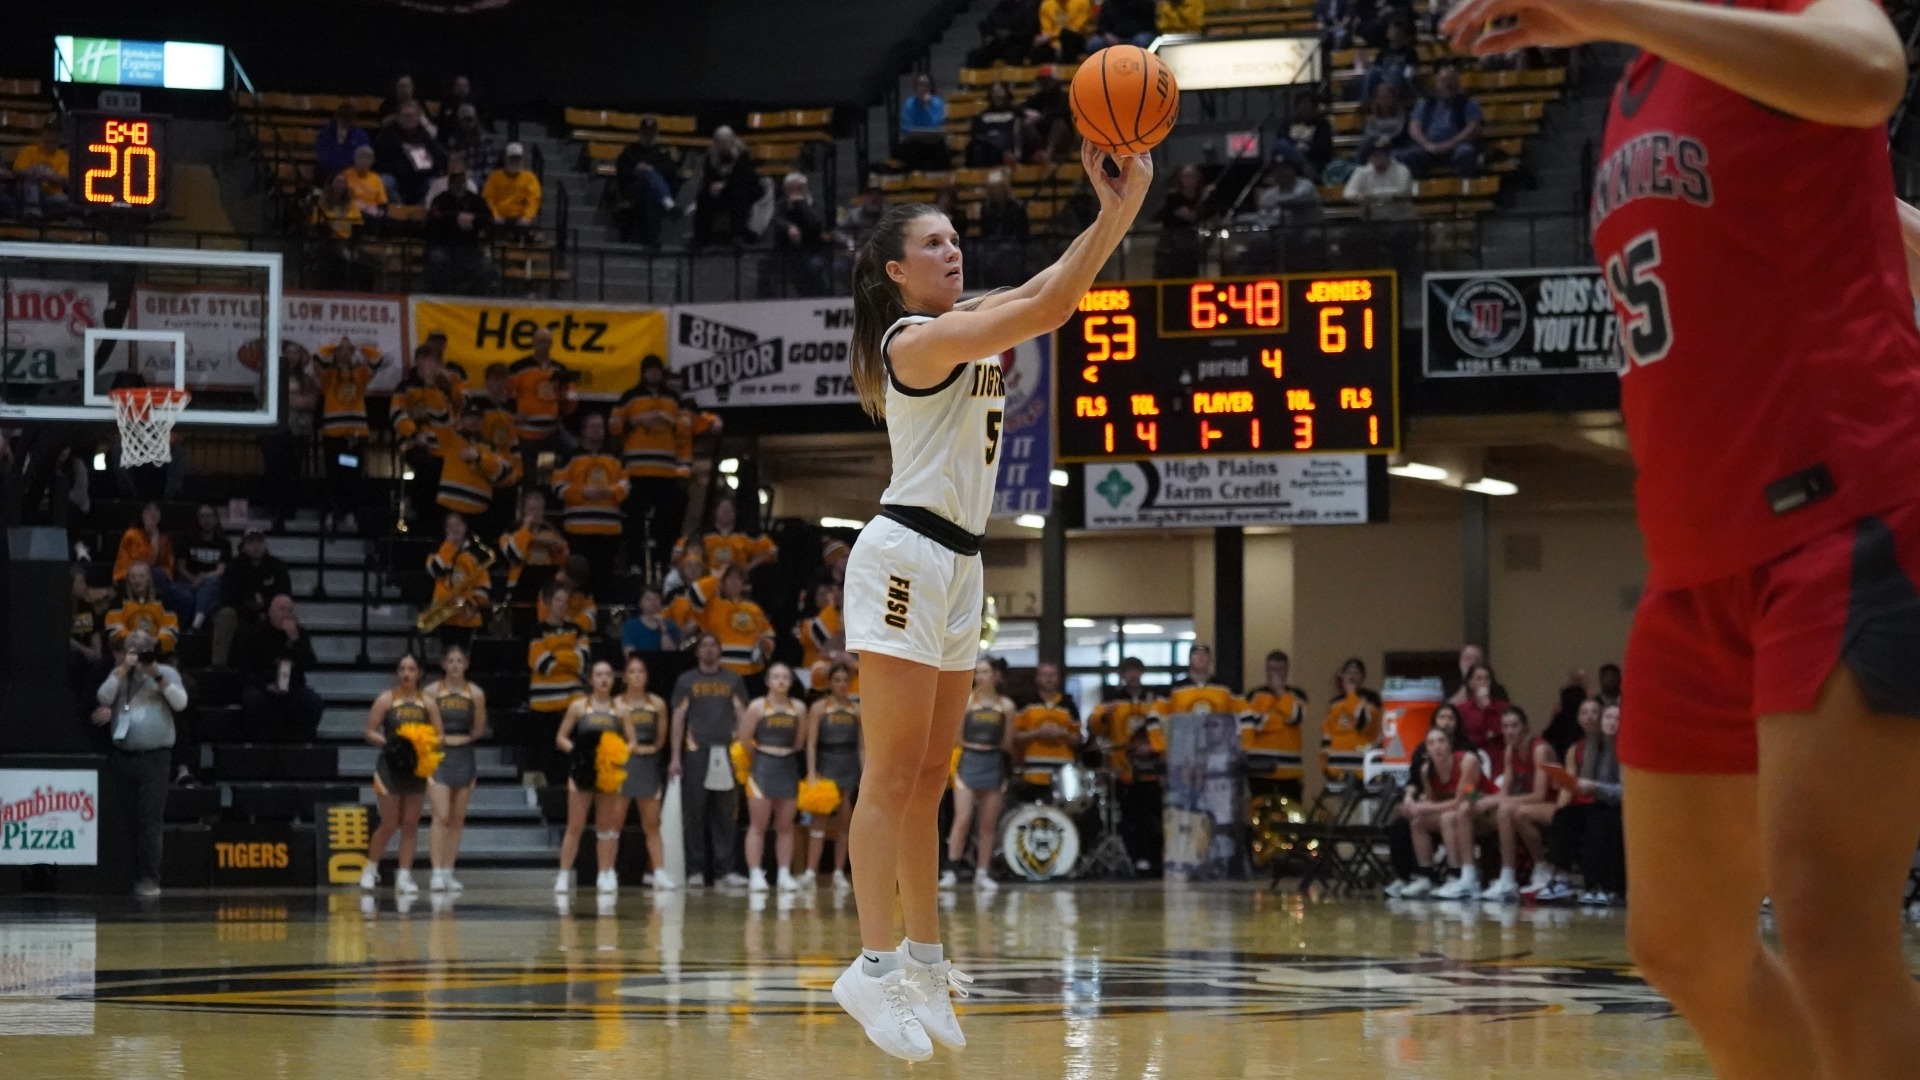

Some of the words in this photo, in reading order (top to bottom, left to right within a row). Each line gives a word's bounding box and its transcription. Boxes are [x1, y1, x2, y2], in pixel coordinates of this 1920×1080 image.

[106, 121, 148, 145] 6:48
[85, 144, 156, 204] 20
[145, 295, 199, 316] GREAT
[288, 301, 323, 321] LOW
[1191, 280, 1280, 329] 6:48
[1537, 277, 1591, 314] SUBS
[689, 319, 732, 352] 8th
[1084, 315, 1137, 361] 53
[1319, 306, 1373, 353] 61
[688, 343, 776, 389] LIQUOR
[788, 341, 848, 365] GOOD
[1198, 357, 1249, 381] period
[1261, 348, 1283, 379] 4
[1076, 395, 1107, 417] FLS
[1131, 394, 1159, 416] TOL
[1193, 390, 1254, 415] PLAYER
[1340, 387, 1372, 410] FLS
[984, 409, 1002, 466] 5
[1105, 422, 1114, 453] 1
[1136, 421, 1157, 451] 4
[1294, 414, 1313, 449] 3
[1369, 414, 1378, 445] 1
[1165, 460, 1210, 483] High
[1218, 458, 1279, 477] Plains
[1165, 483, 1213, 499] Farm
[1220, 480, 1280, 499] Credit
[885, 574, 910, 630] FHSU
[0, 785, 95, 823] ambino's
[2, 820, 76, 850] Pizza
[214, 842, 288, 868] TIGERS
